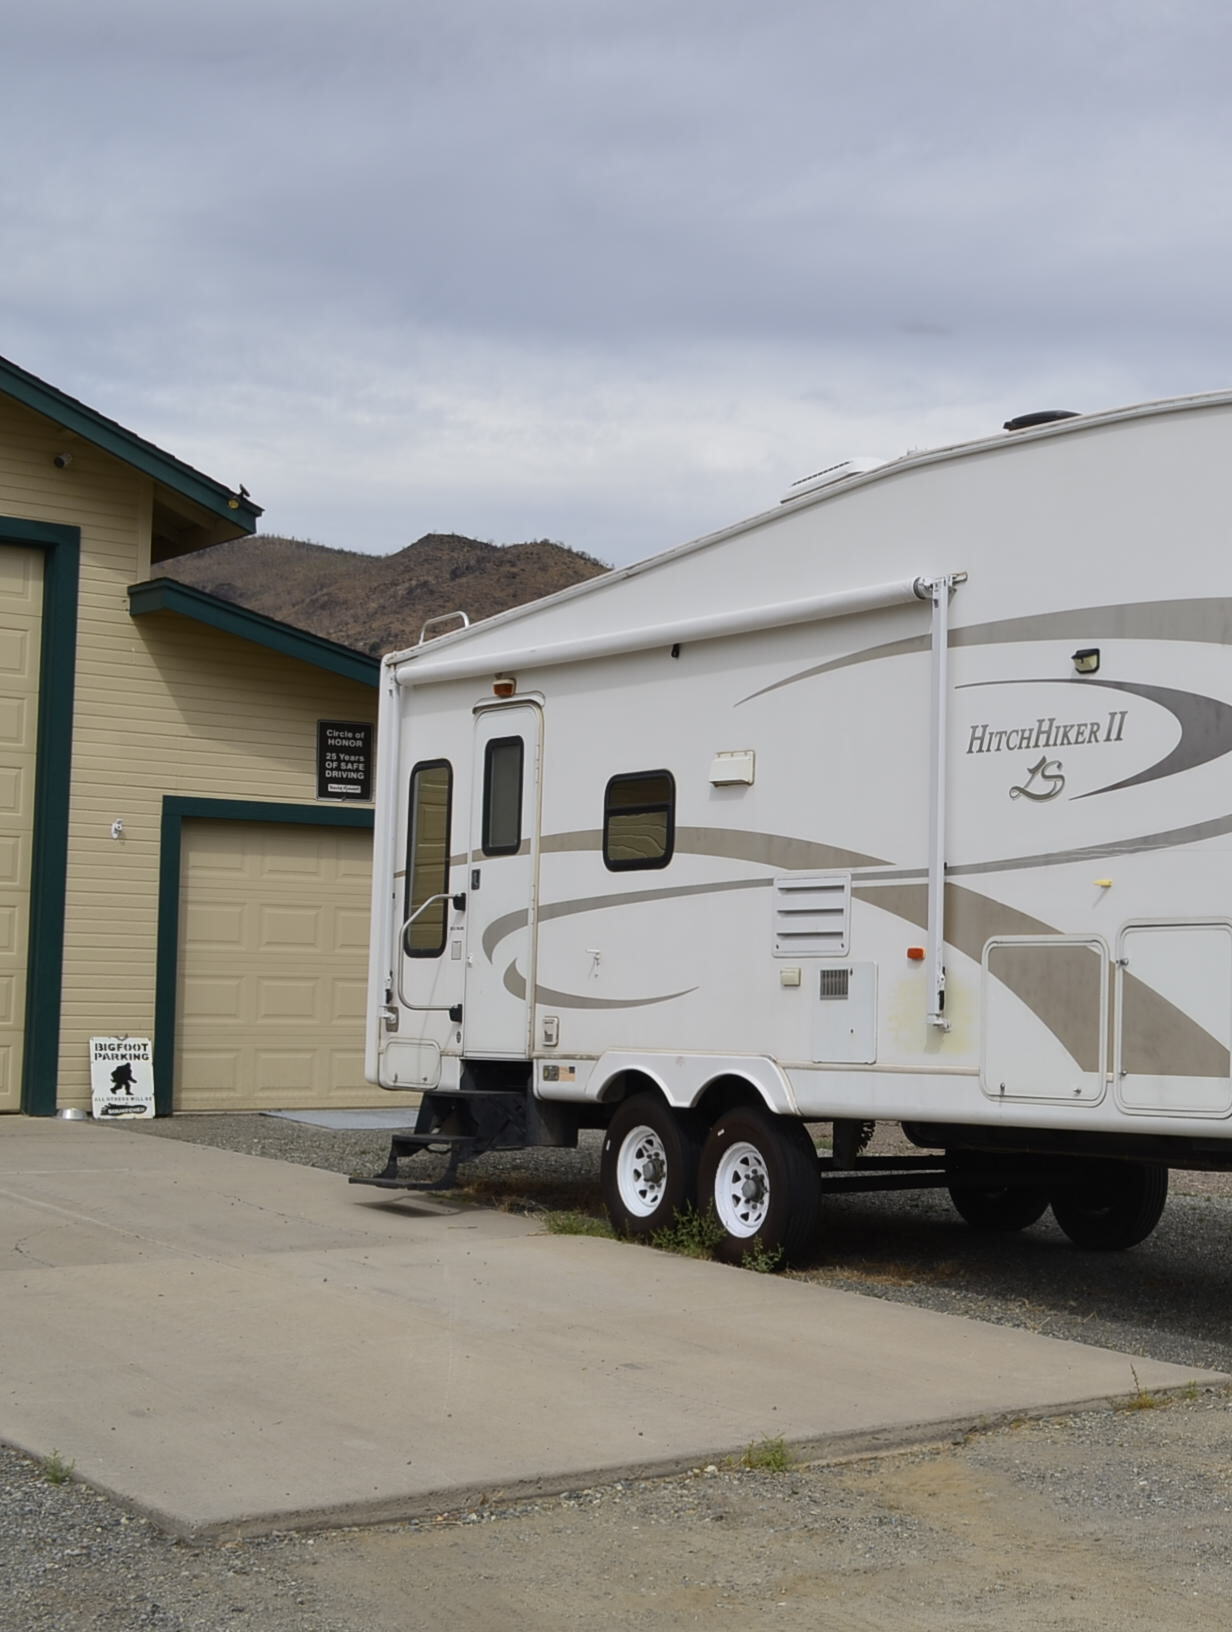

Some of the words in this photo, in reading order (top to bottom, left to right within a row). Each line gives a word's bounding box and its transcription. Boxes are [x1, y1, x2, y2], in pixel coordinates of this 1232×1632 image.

[1102, 710, 1129, 742] II
[326, 729, 353, 738] Circle
[354, 731, 365, 739] of
[327, 738, 363, 747] HONOR
[325, 752, 337, 760] 25
[338, 753, 365, 762] Years
[325, 761, 338, 769] OF
[340, 762, 365, 770] SAFE
[325, 770, 365, 779] DRIVING
[94, 1043, 149, 1052] BIGFOOT
[94, 1052, 150, 1061] PARKING
